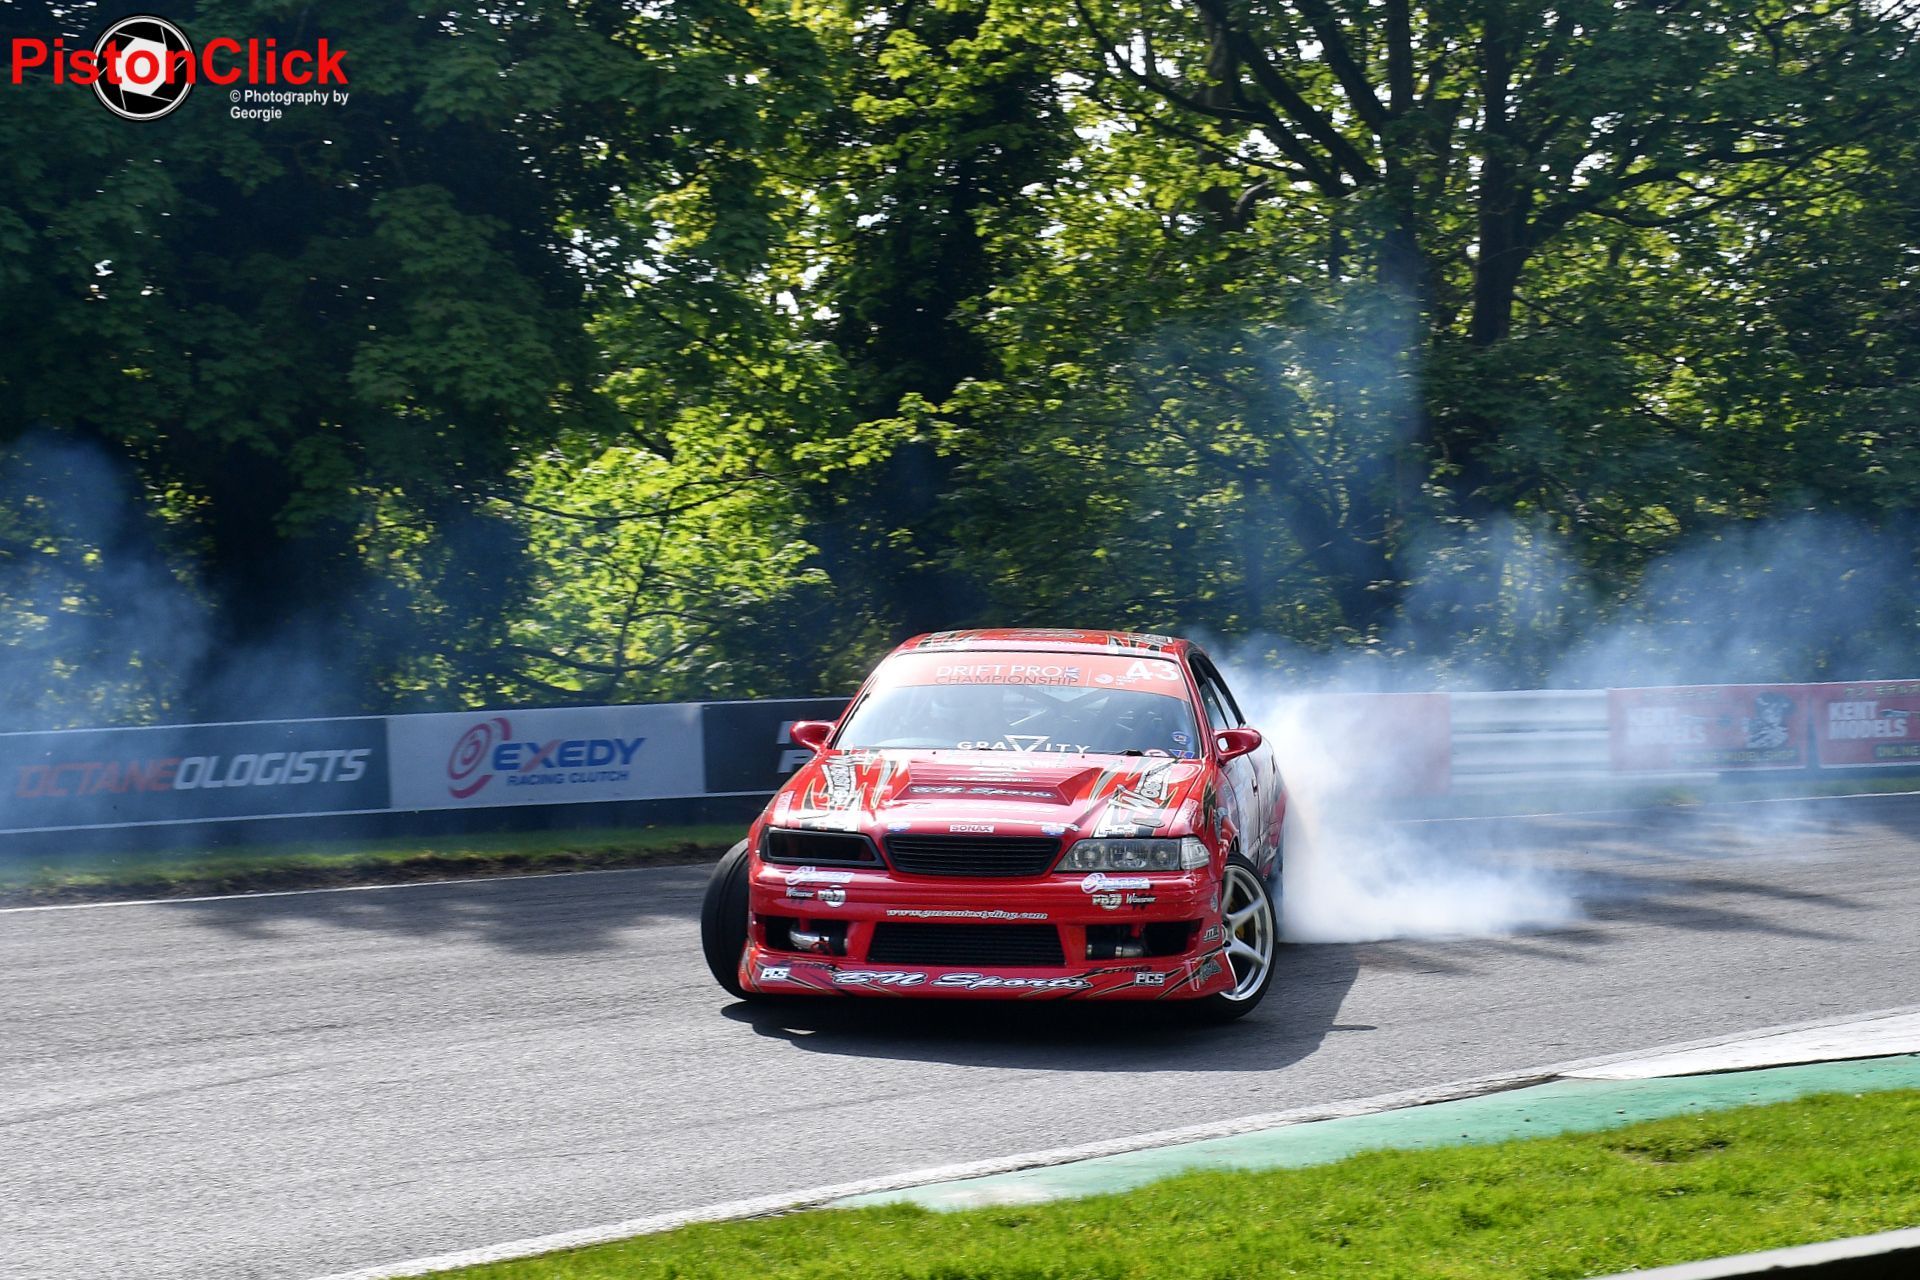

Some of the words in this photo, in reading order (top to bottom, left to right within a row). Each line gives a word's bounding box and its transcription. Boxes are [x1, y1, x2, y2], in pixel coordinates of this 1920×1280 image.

[936, 665, 1008, 677] DRIFT
[1010, 665, 1063, 678] PRO
[1126, 660, 1180, 681] A3
[934, 675, 1078, 686] CHAMPIONSHIP
[1829, 701, 1878, 719] KENT
[1829, 719, 1908, 739] MODELS
[492, 737, 646, 771] EXEDY
[506, 773, 566, 787] RACING
[568, 770, 630, 785] CLUTCH
